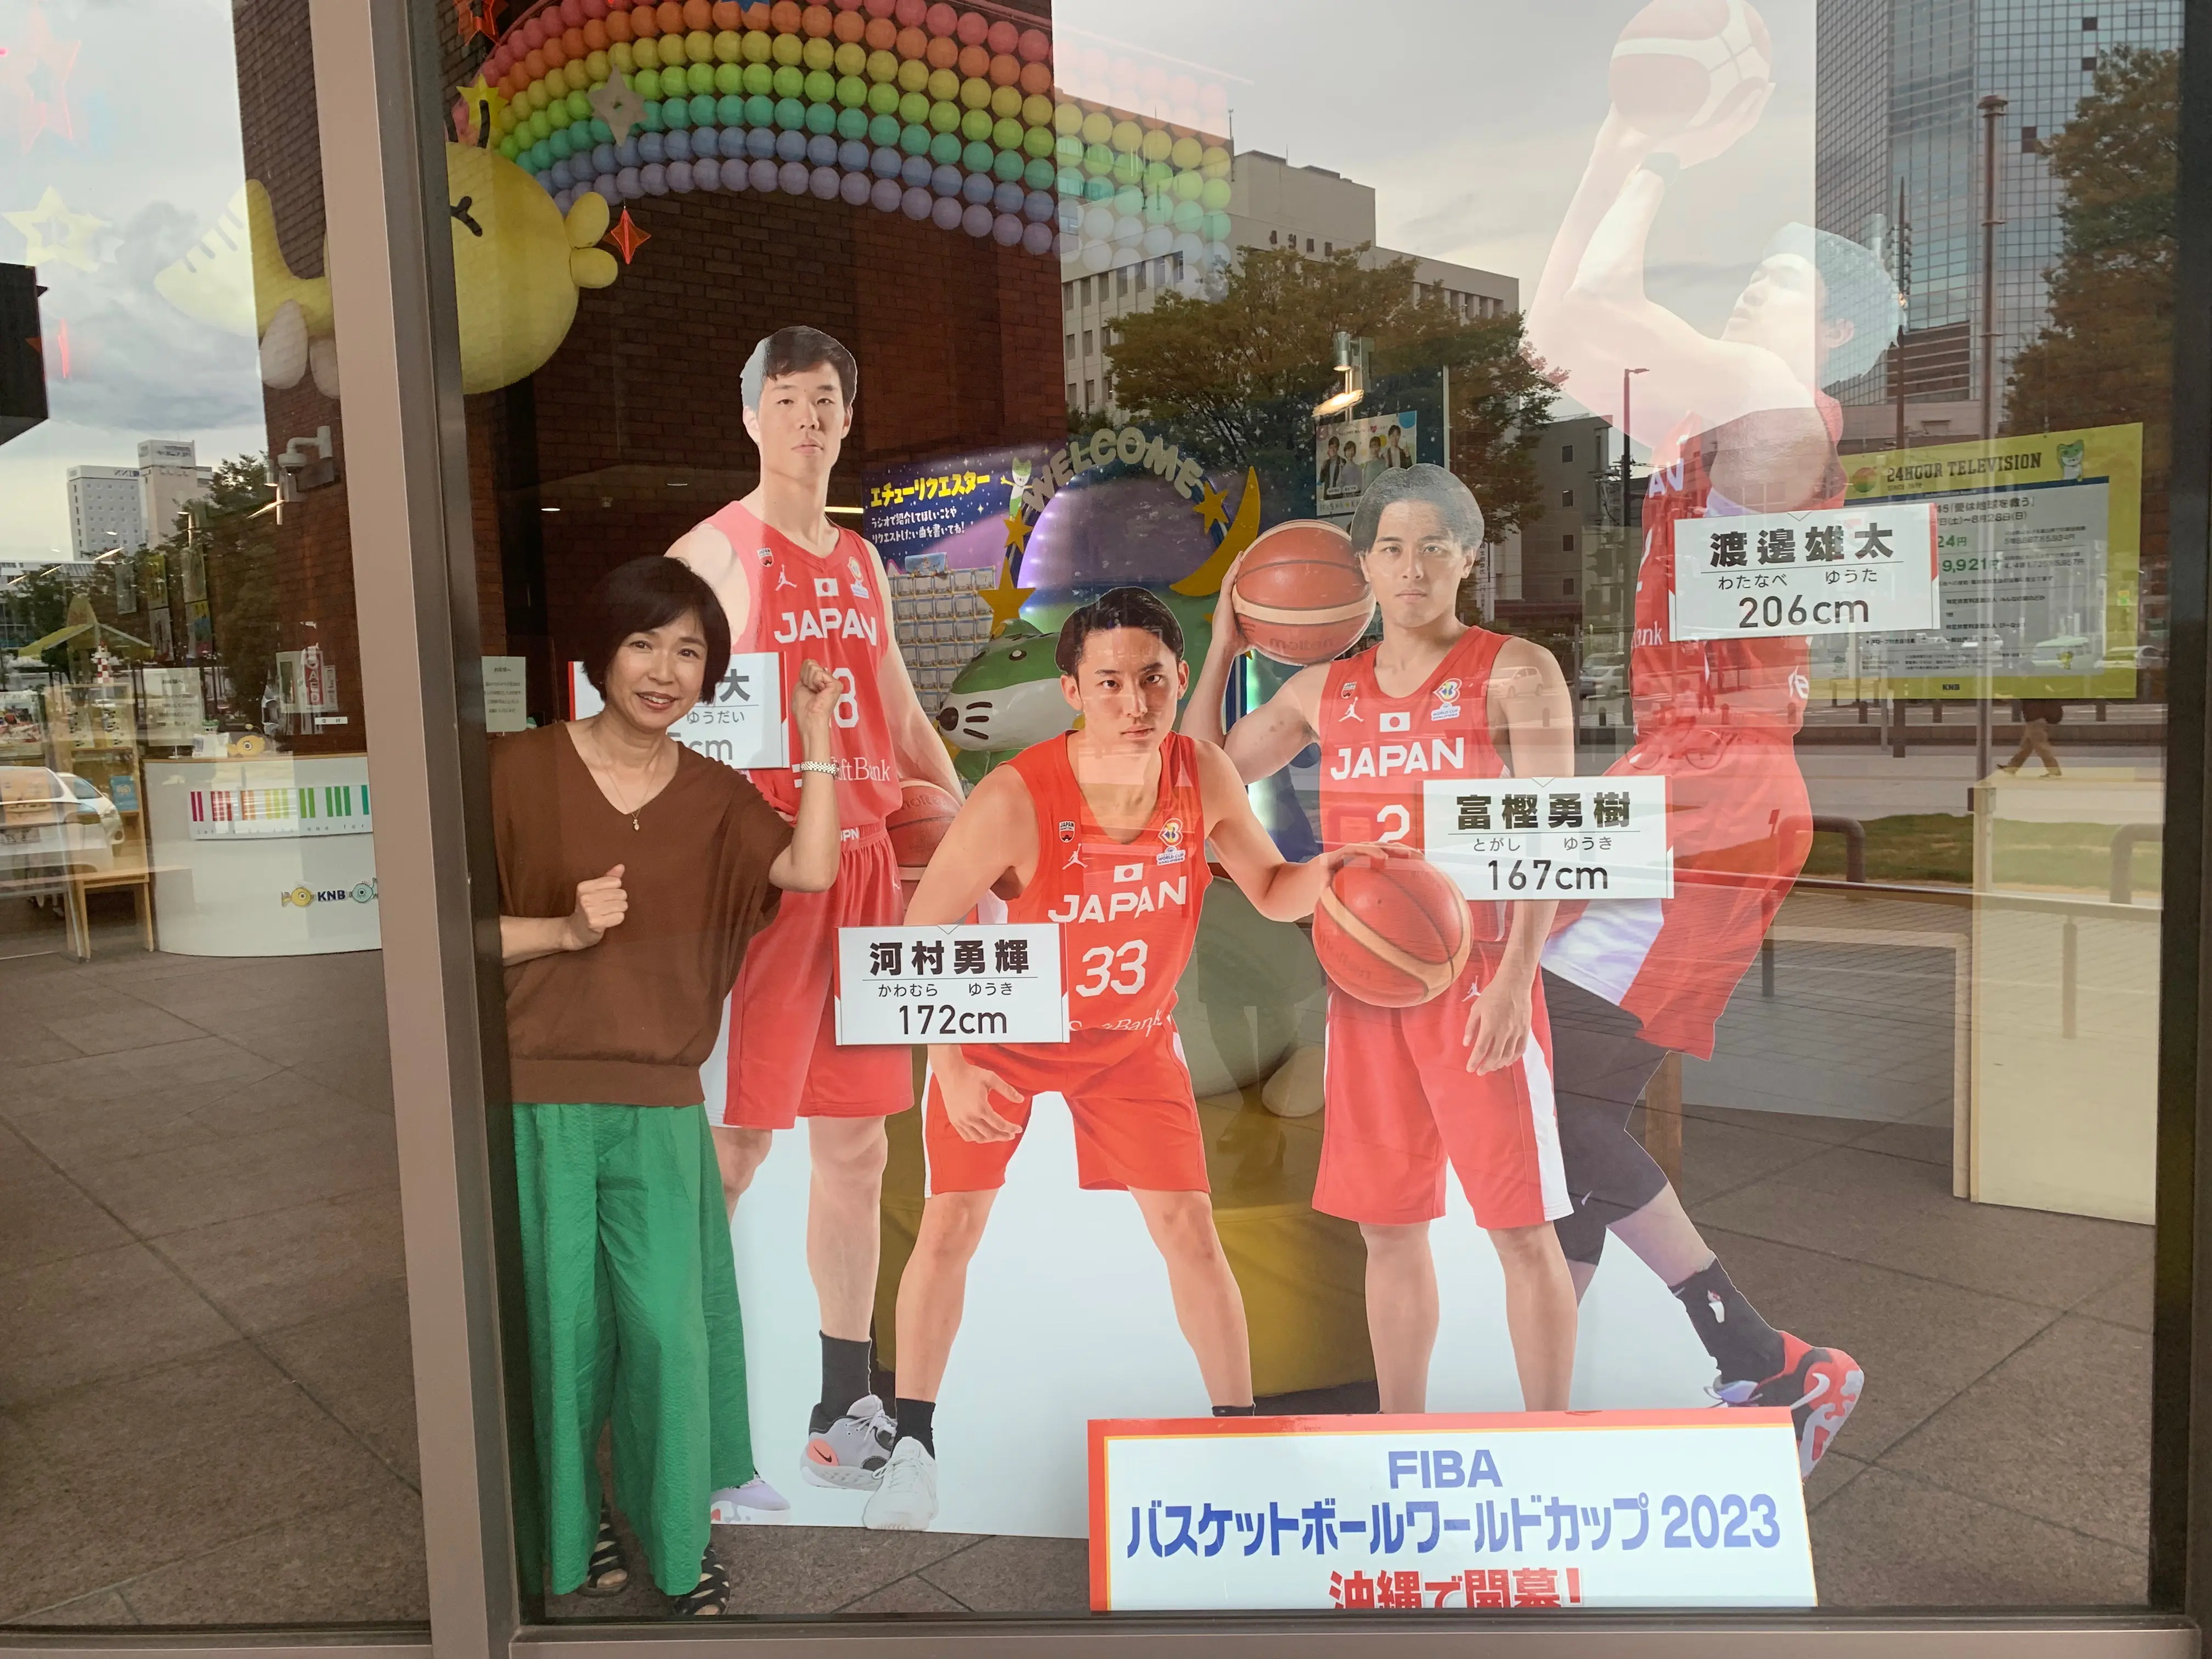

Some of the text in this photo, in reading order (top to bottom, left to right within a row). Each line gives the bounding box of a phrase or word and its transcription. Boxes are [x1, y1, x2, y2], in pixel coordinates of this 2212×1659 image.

[1023, 426, 1205, 513] WELCOME
[1887, 452, 2042, 483] 24HOUR TELEVISION
[870, 470, 990, 507] エチューリクエスター
[871, 506, 957, 529] ラジオで紹介してほしいことや
[1709, 522, 1894, 568] 渡邊雄太
[1718, 568, 1877, 590] わたなべ ゆうた
[774, 608, 877, 646] JAPAN
[1739, 594, 1869, 628] 206cm
[308, 669, 319, 703] AED
[720, 669, 751, 702] 大
[687, 711, 744, 725] ゆうだい
[1330, 737, 1465, 781] JAPAN
[1376, 804, 1410, 843] 2
[1456, 791, 1631, 831] 富樫勇樹
[1473, 836, 1613, 853] とがし ゆうき
[1488, 859, 1608, 891] 167cm
[317, 890, 346, 902] KNB
[1048, 876, 1187, 924] JAPAN
[869, 939, 1029, 977] 河村勇輝
[1076, 939, 1148, 997] 33
[878, 982, 1014, 998] かわむら ゆうき
[899, 1004, 1008, 1036] 172cm
[1388, 1449, 1503, 1489] FIBA
[1126, 1492, 1781, 1559] バスケットボールワールドカップ 2023
